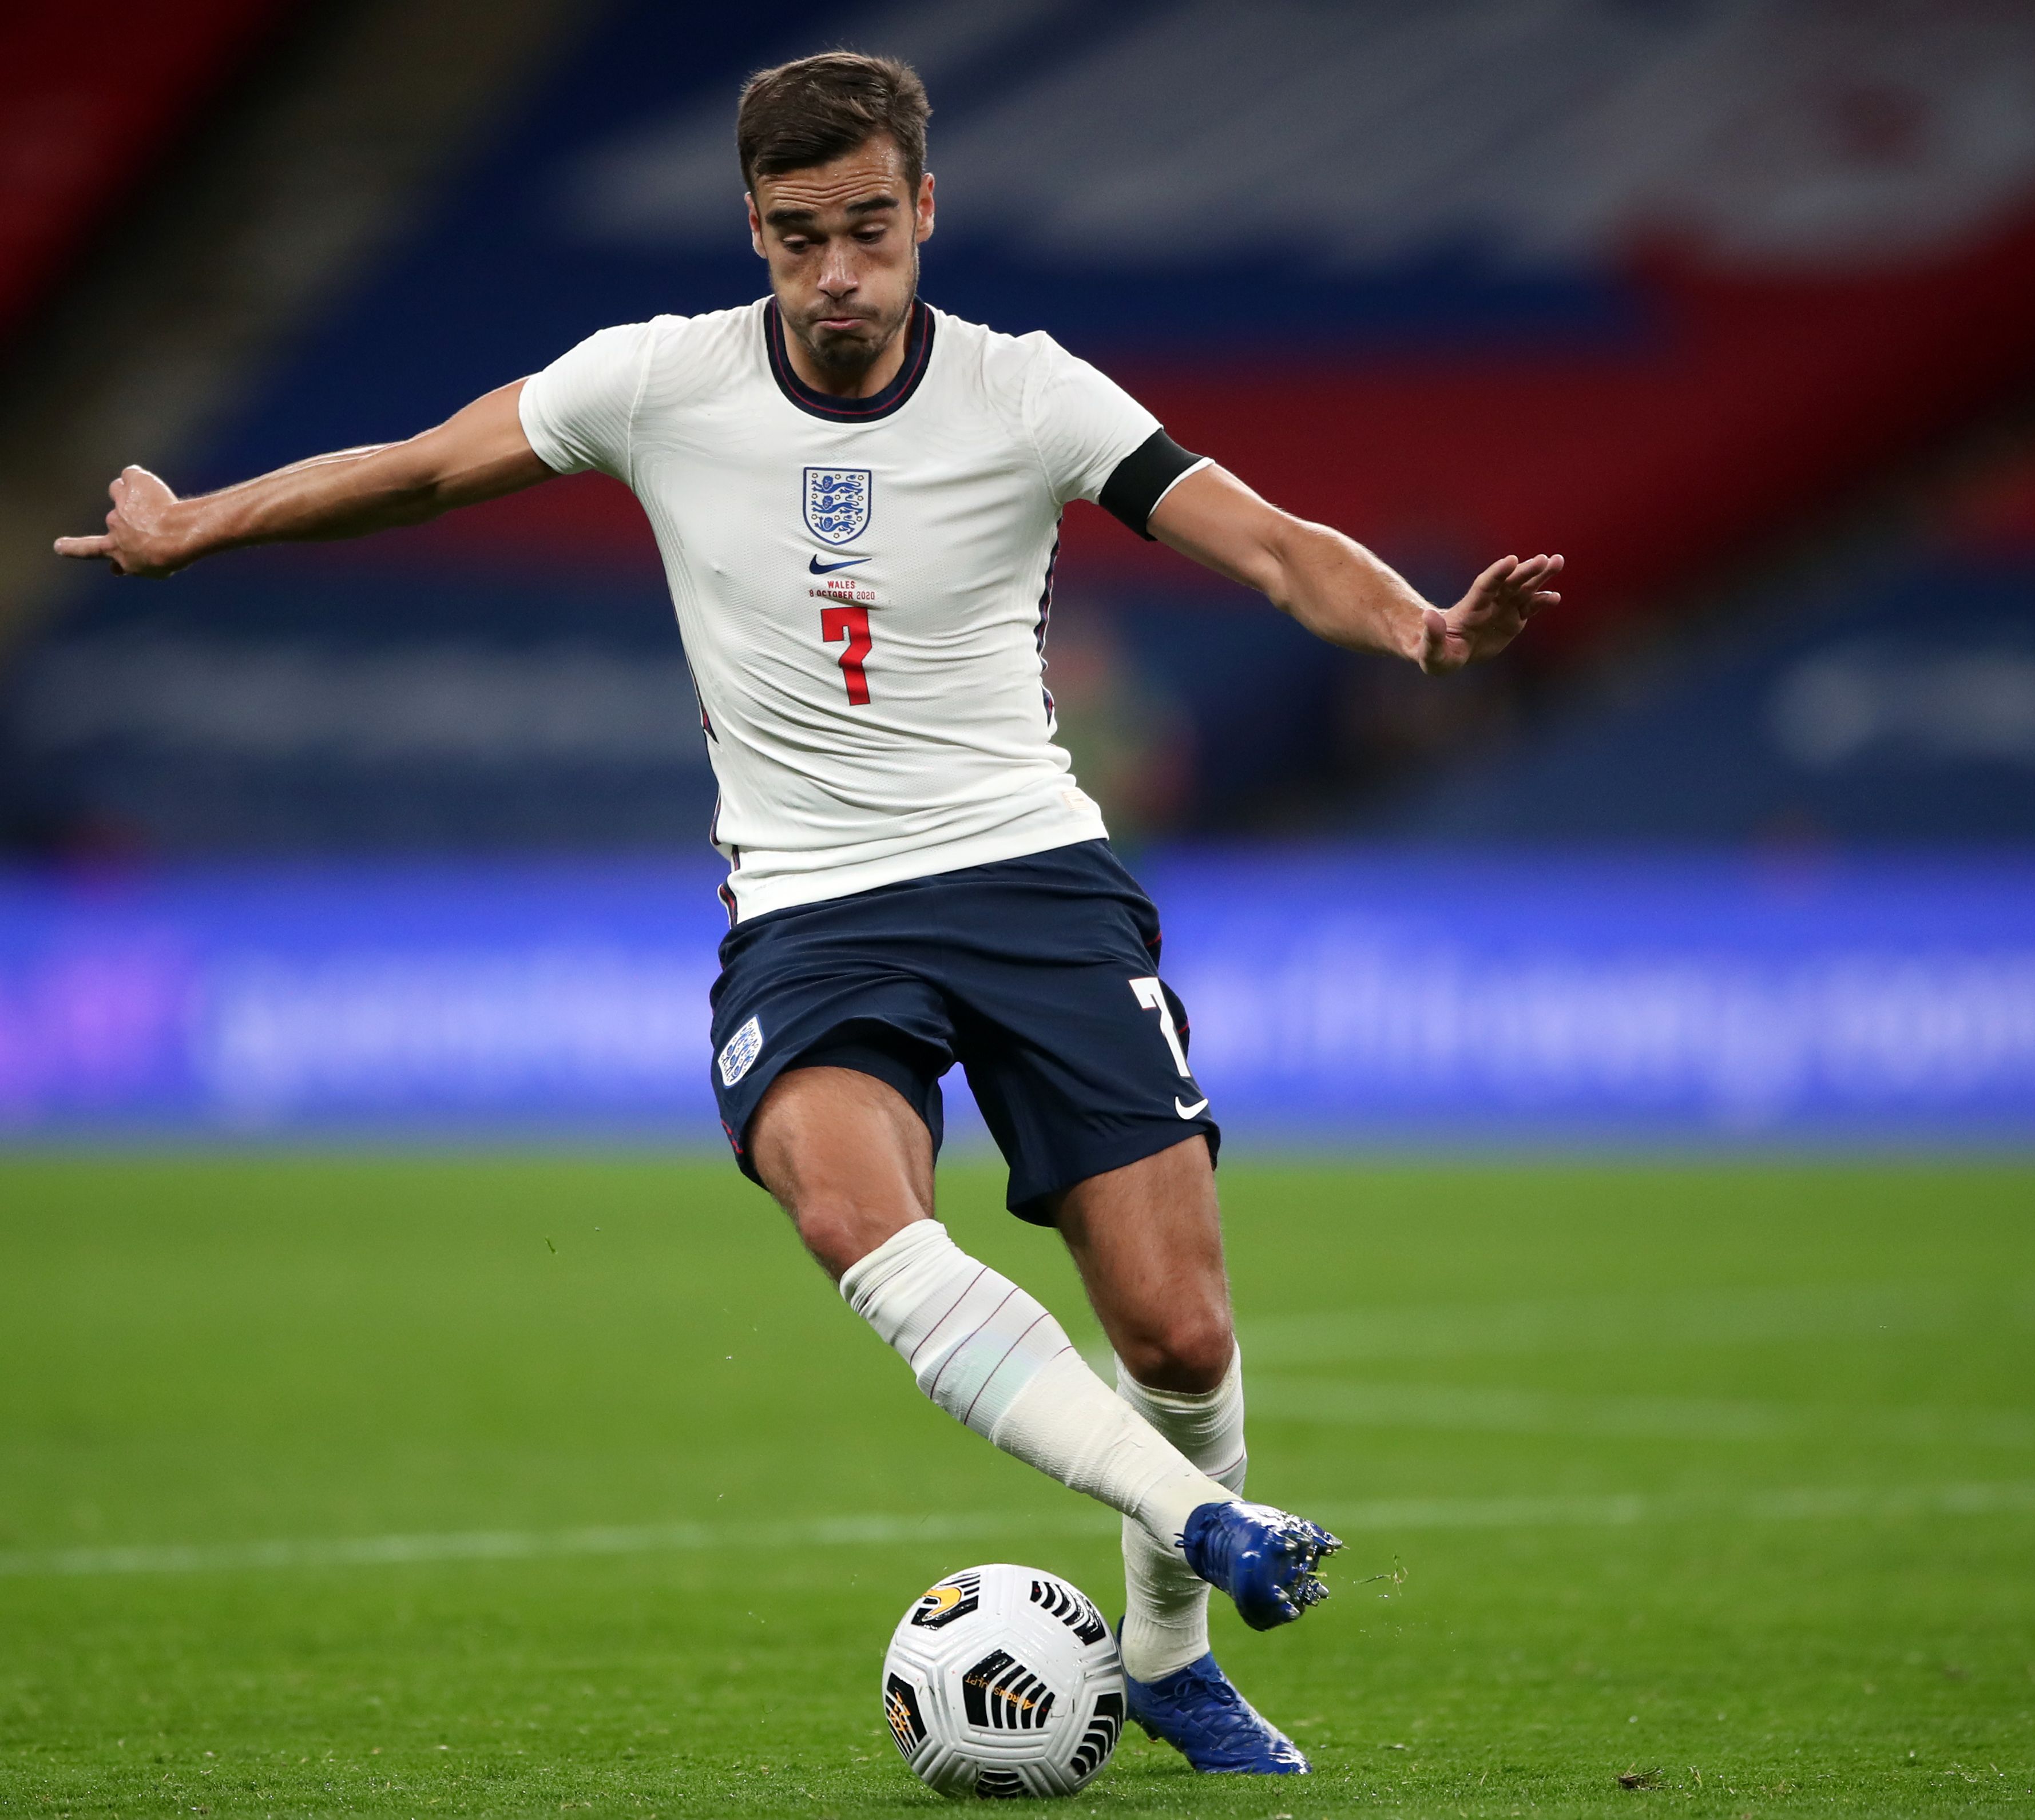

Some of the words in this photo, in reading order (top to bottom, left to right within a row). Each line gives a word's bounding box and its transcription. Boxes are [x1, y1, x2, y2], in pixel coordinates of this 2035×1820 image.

[809, 589, 814, 597] 8
[816, 590, 854, 599] OCTOBER
[856, 591, 875, 600] 2020
[827, 581, 855, 589] WALES
[820, 606, 872, 706] 7
[1128, 976, 1191, 1078] 7
[965, 1674, 1037, 1711] AEROWSULPT
